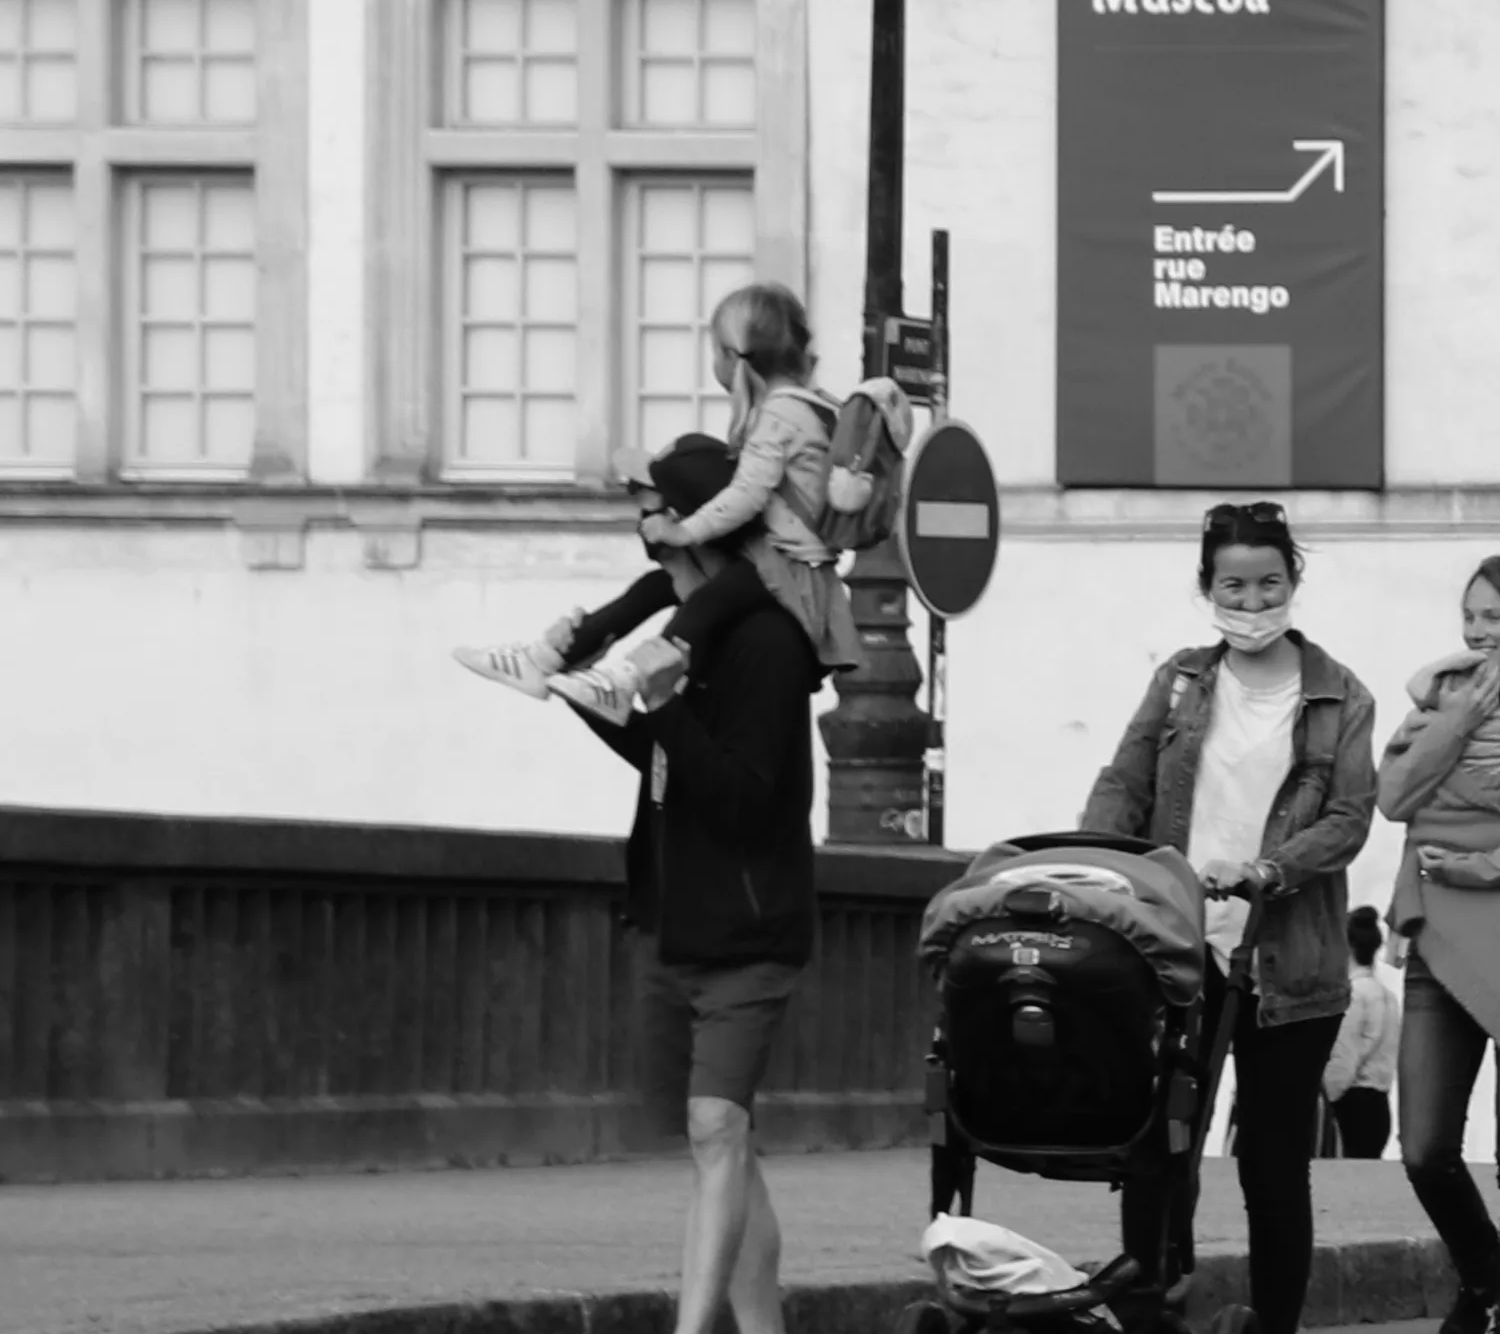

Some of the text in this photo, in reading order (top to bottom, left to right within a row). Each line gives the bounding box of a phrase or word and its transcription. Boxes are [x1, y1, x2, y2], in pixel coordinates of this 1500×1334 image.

[1153, 224, 1256, 253] Entrée
[1153, 258, 1206, 280] rue
[1154, 281, 1291, 314] Marengo
